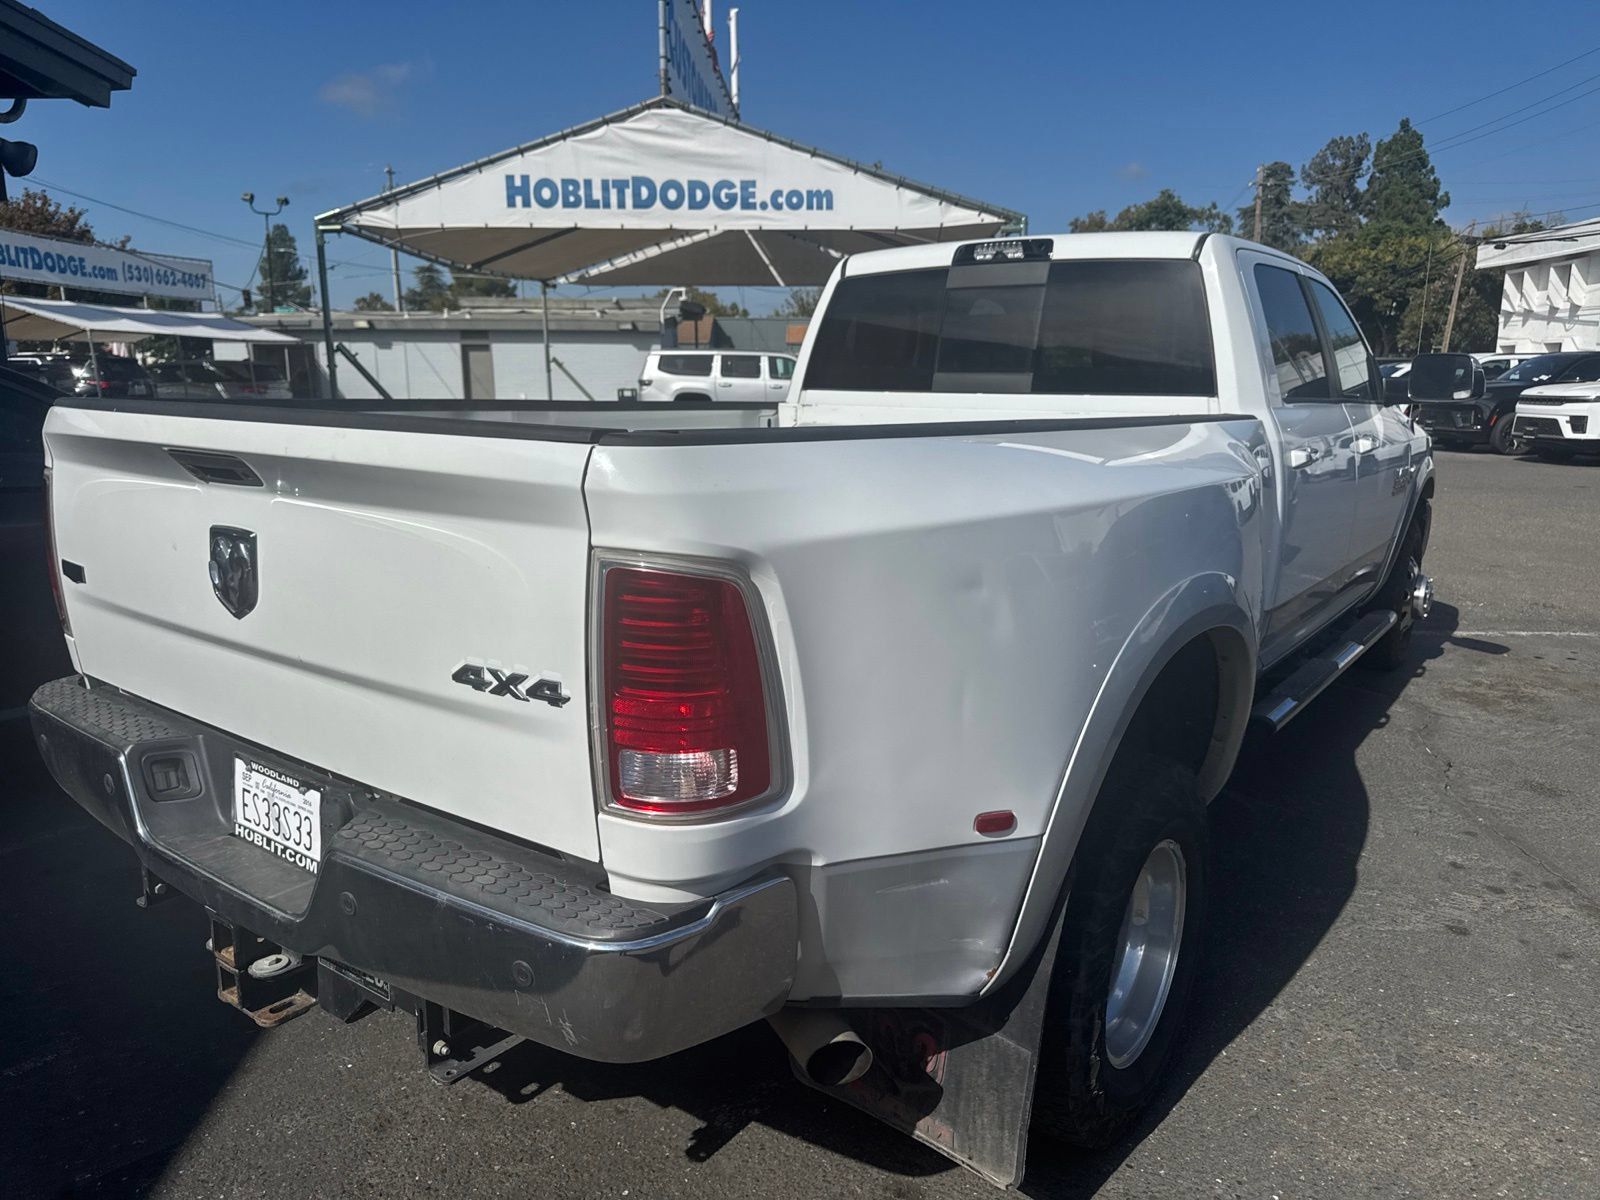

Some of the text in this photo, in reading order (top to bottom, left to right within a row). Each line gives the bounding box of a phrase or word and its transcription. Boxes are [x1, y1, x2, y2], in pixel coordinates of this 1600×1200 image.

[505, 174, 834, 211] HOBLITDODGE.com
[250, 761, 300, 788] WOODLAND
[242, 787, 312, 852] ES33S33
[235, 823, 318, 874] HOBLIT.COM
